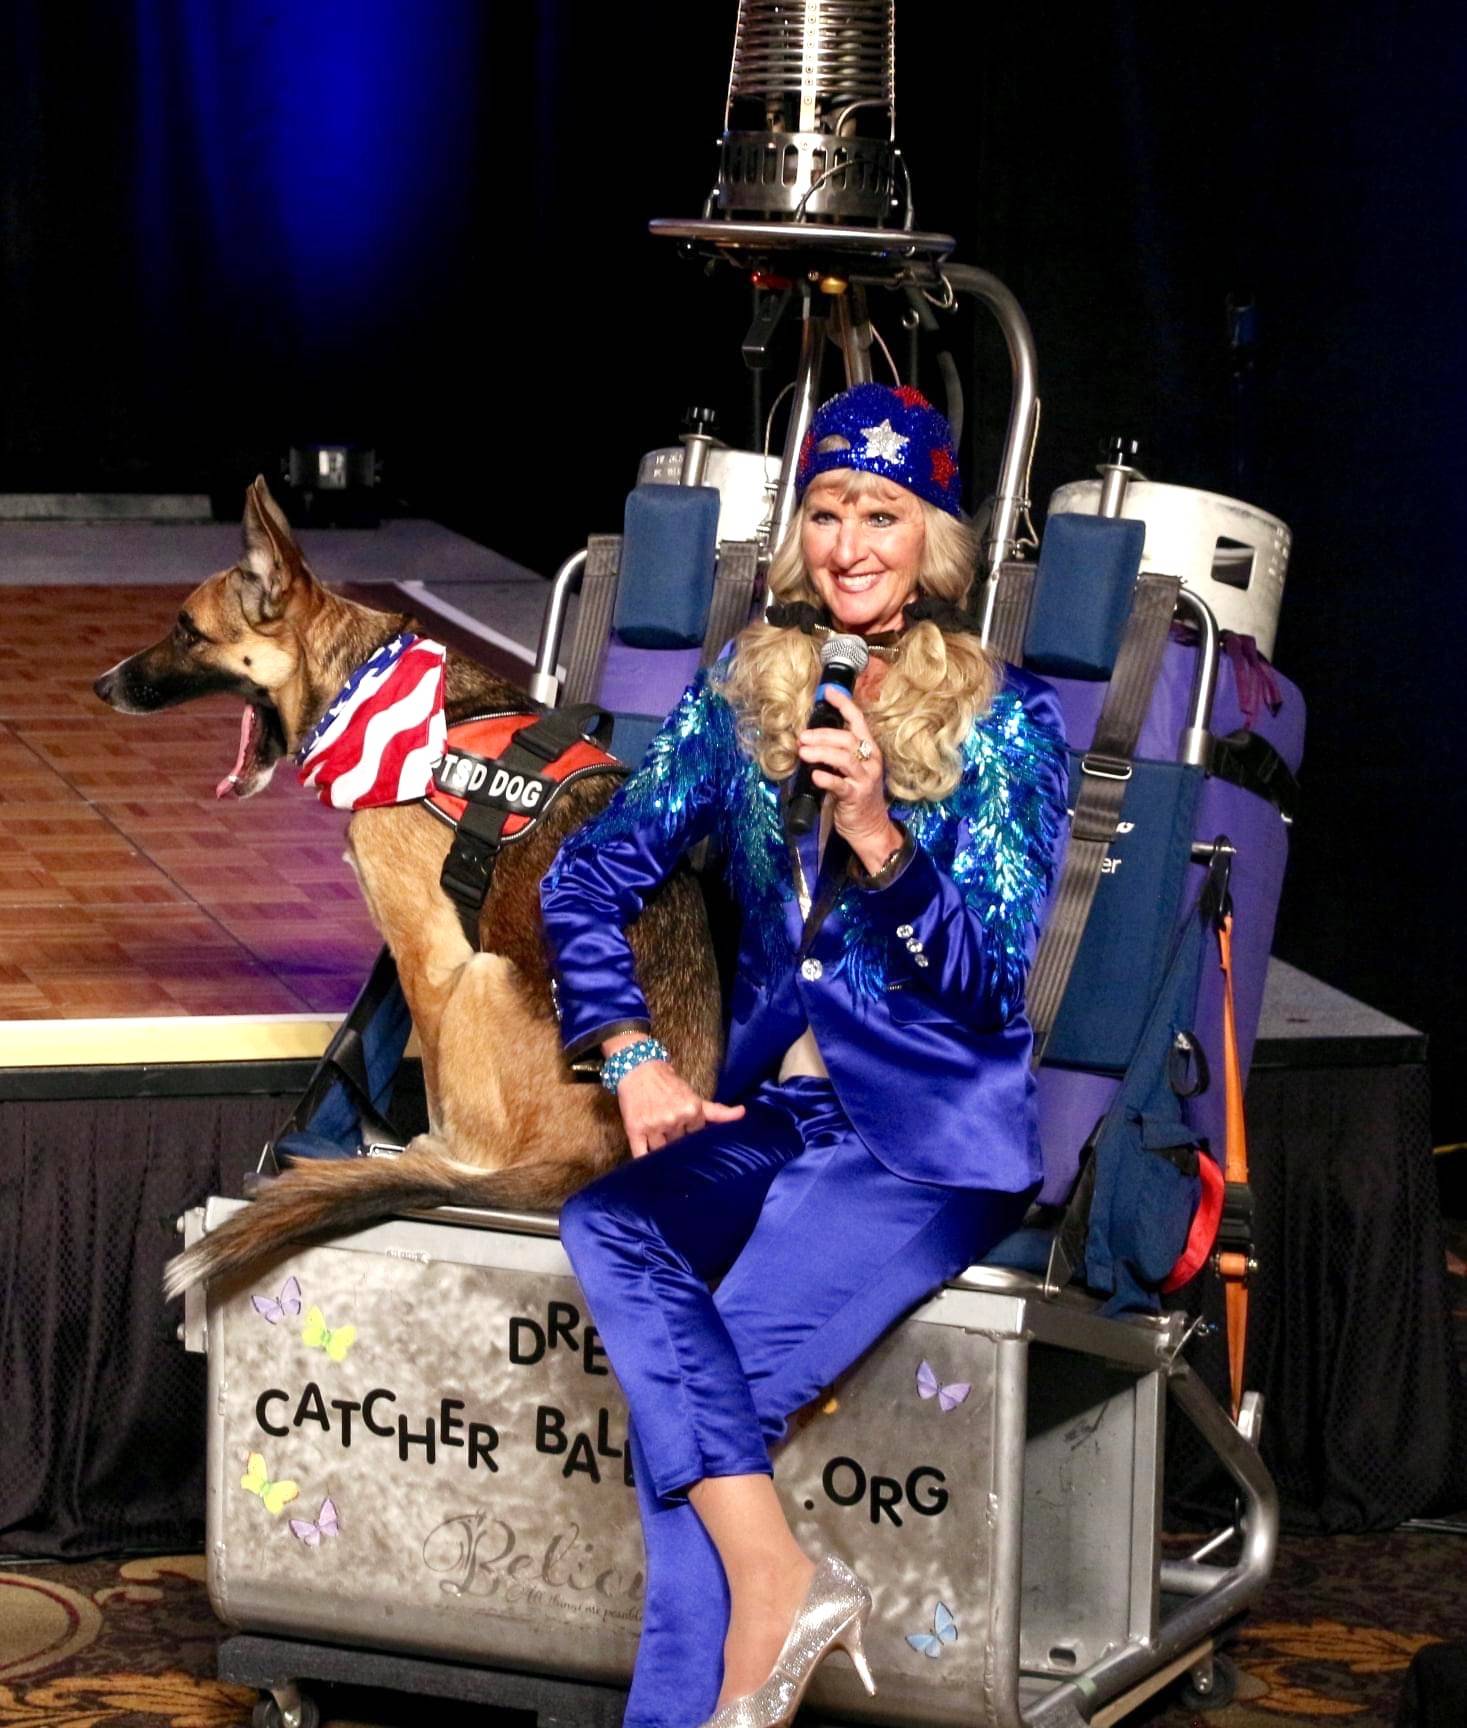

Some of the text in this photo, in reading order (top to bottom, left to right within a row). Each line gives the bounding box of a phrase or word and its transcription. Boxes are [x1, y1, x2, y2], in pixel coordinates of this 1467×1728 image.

[488, 769, 543, 808] DOG
[255, 1382, 499, 1473] CATCHER
[804, 1456, 949, 1527] .ORG
